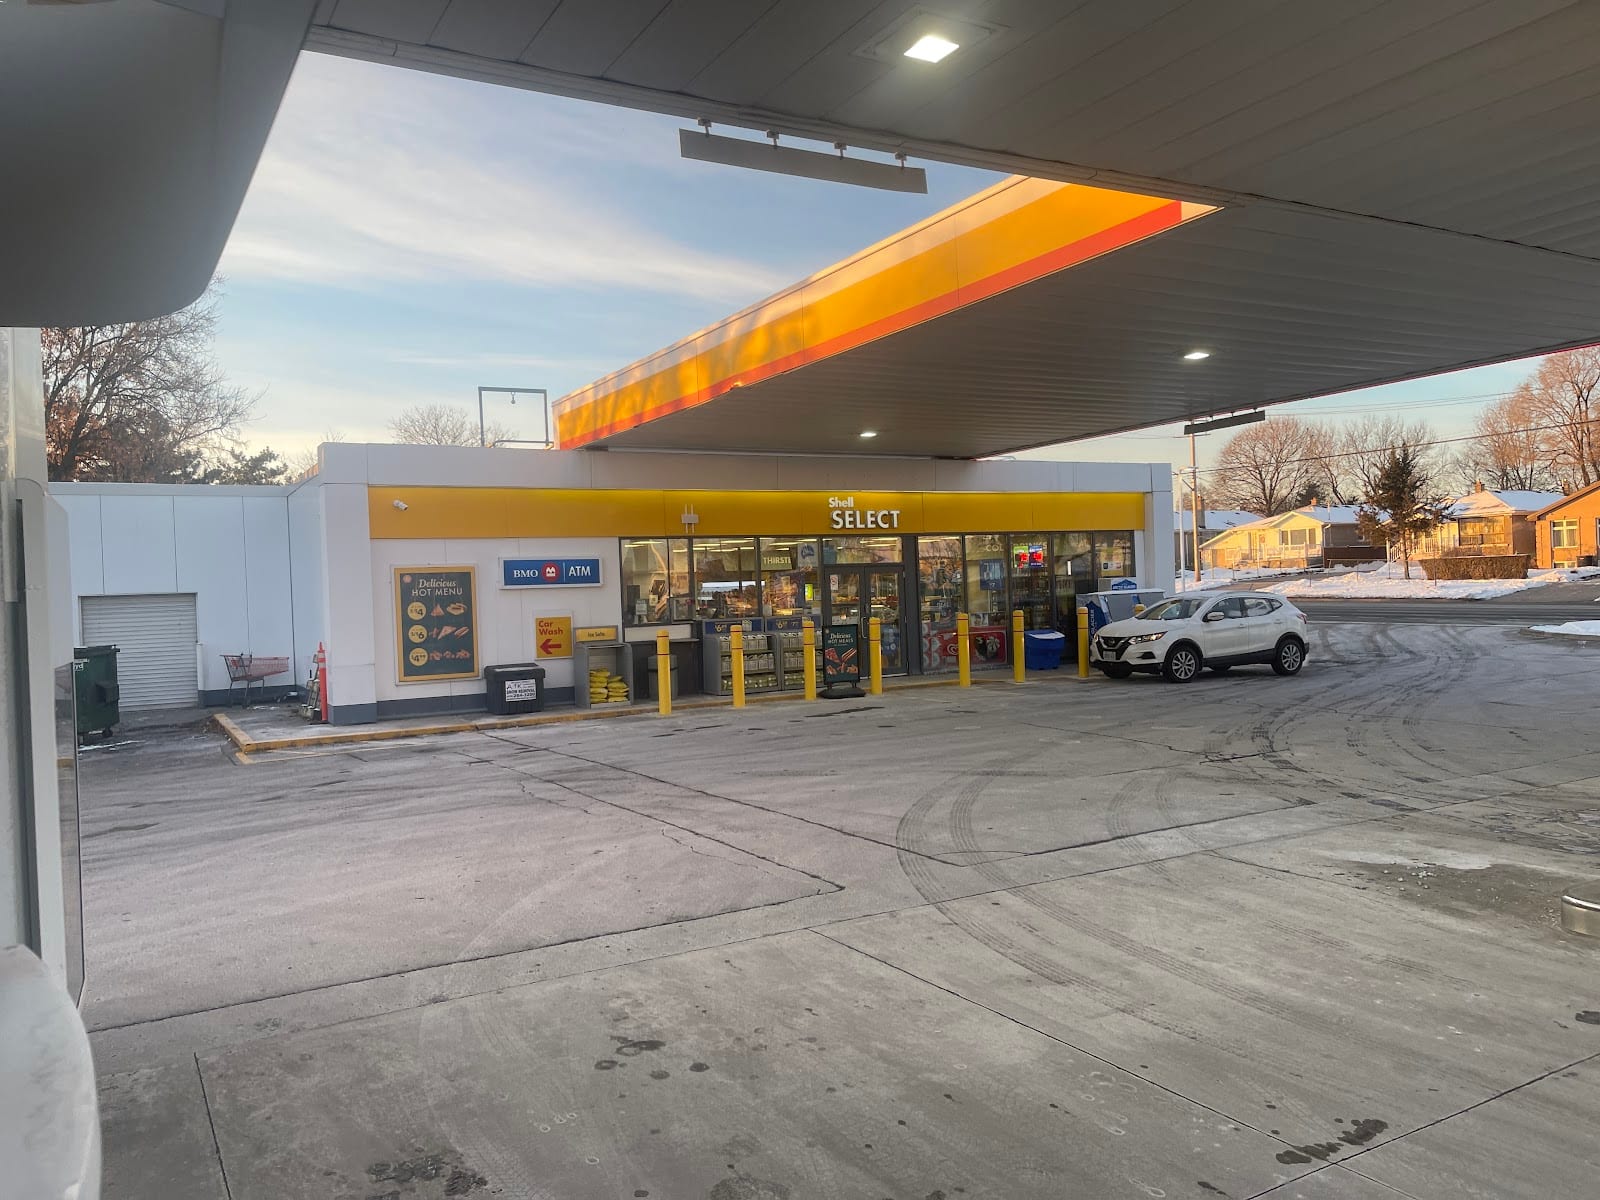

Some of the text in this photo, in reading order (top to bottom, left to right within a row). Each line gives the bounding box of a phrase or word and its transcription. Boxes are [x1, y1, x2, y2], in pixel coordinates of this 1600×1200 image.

[828, 496, 854, 508] Shell
[831, 510, 900, 529] SELECT
[513, 566, 591, 578] BMO ATM
[419, 579, 457, 588] Delicious
[412, 587, 463, 597] HOT MENU
[538, 620, 554, 628] Car
[538, 628, 564, 636] Wash
